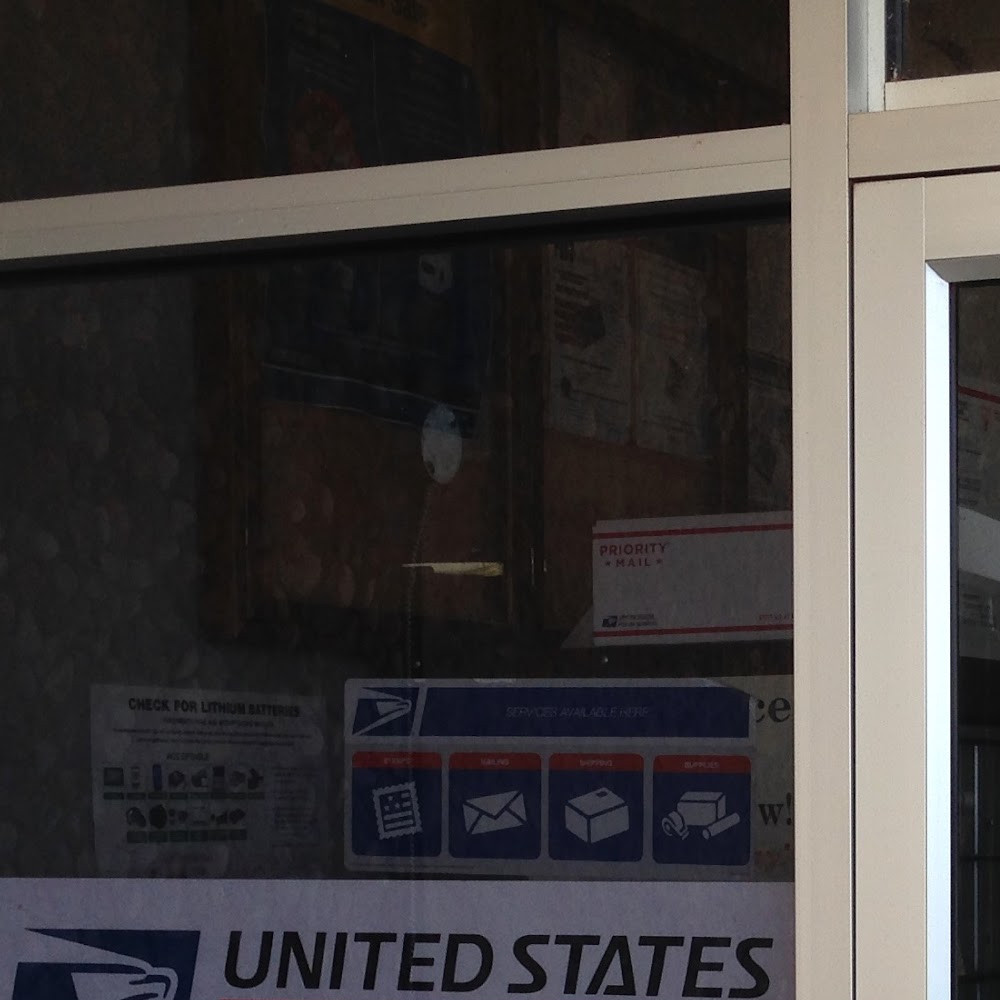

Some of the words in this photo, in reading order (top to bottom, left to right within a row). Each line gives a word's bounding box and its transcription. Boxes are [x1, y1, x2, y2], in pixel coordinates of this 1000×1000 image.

[600, 543, 666, 556] PRIORITY
[615, 558, 652, 568] MAIL
[128, 698, 170, 712] CHECK
[174, 700, 197, 713] FOR
[201, 701, 246, 716] LITHIUM
[560, 706, 616, 719] AVAILABLE
[223, 930, 495, 995] UNITED
[506, 934, 774, 999] STATES
